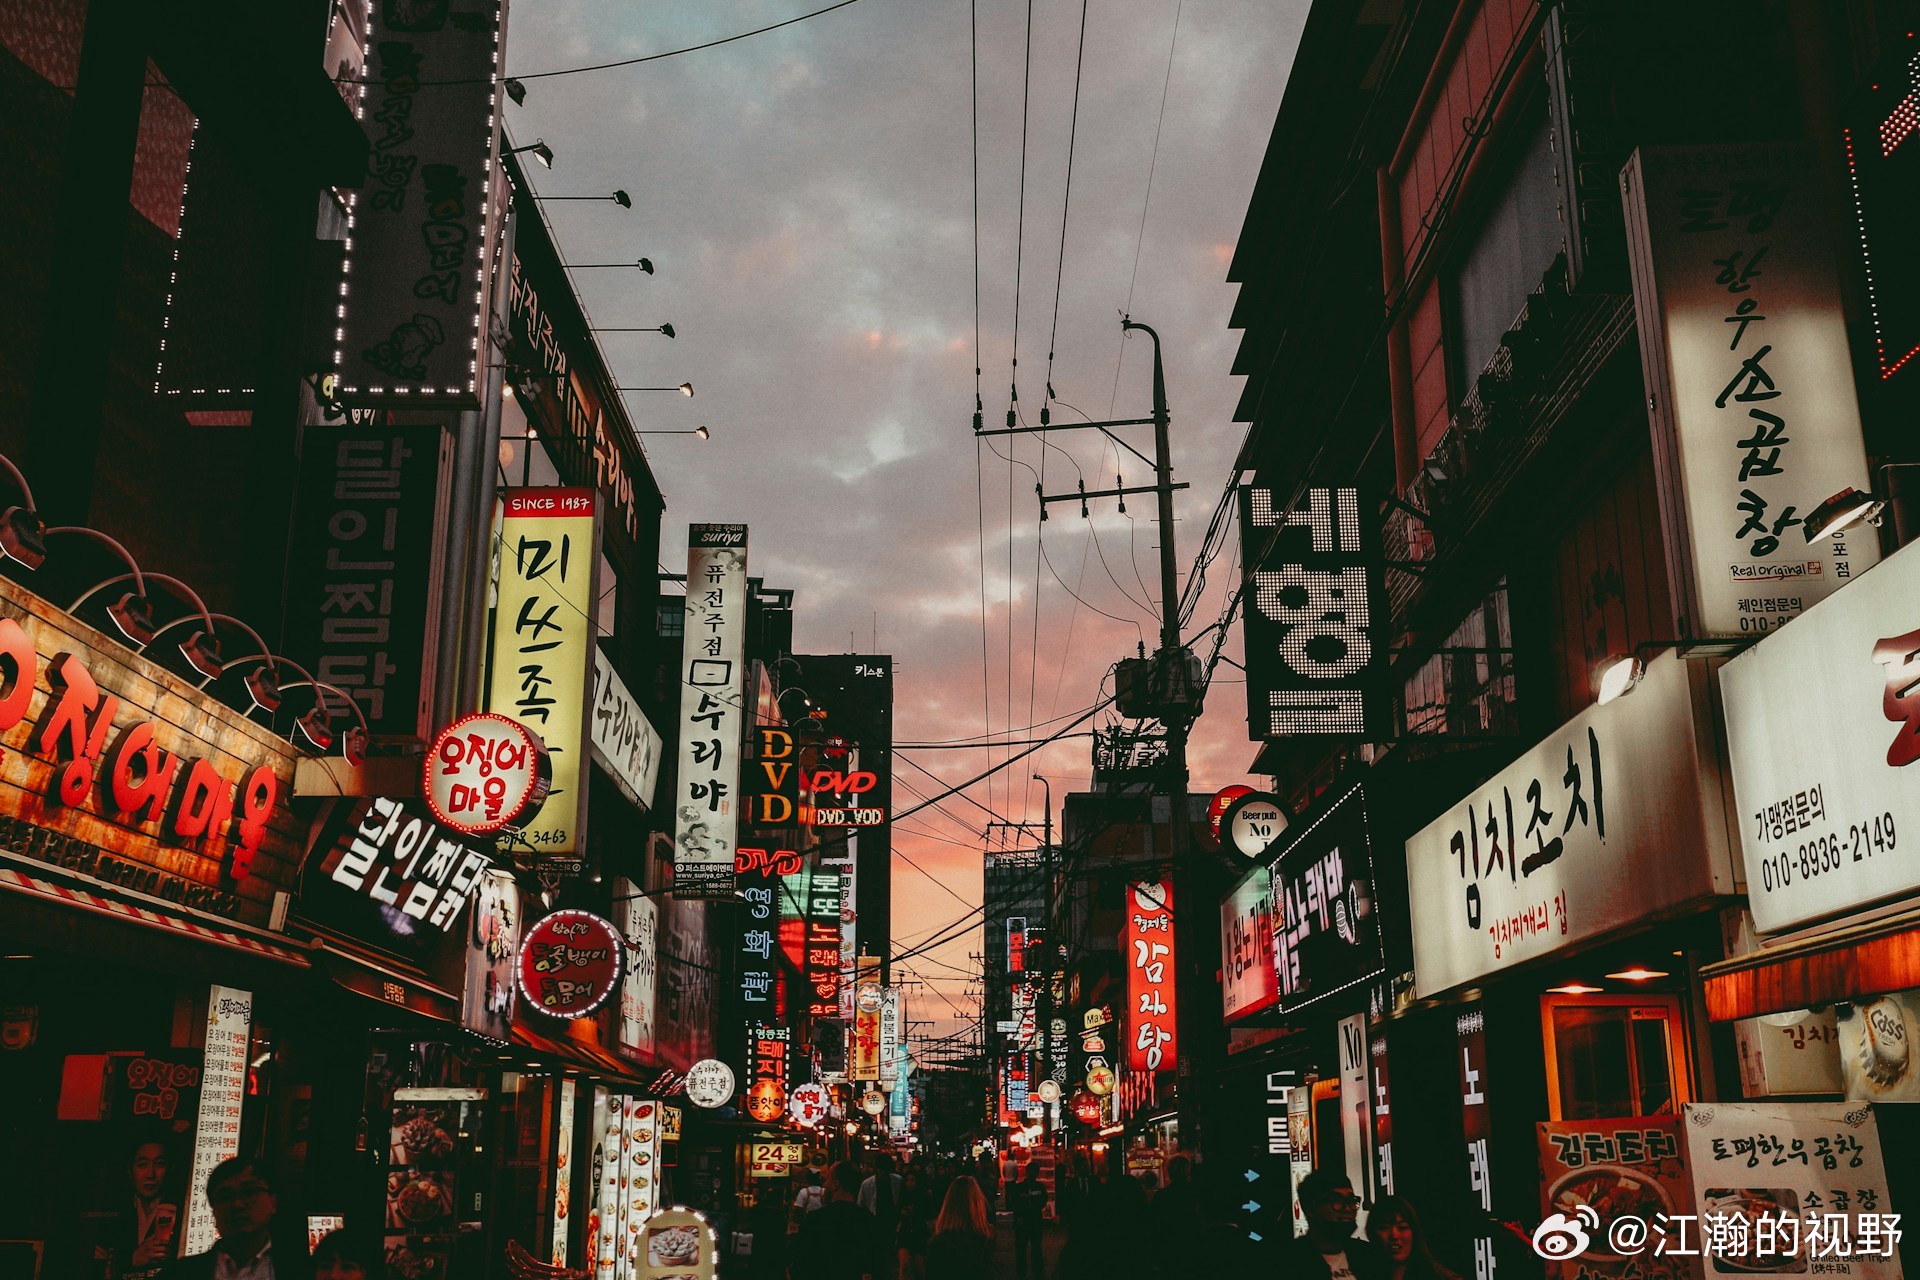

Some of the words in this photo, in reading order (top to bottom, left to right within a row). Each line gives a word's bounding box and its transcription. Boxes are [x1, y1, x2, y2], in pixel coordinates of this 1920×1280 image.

[1715, 344, 1805, 558] 소곱창
[512, 499, 555, 511] SINCE
[561, 497, 590, 510] 1987
[701, 530, 743, 545] suriya
[1731, 564, 1765, 579] Real
[702, 564, 726, 656] 퓨전주점
[1737, 597, 1802, 613] 체인점문의
[514, 534, 570, 796] 미쓰족
[440, 734, 526, 778] 오징어
[690, 693, 728, 811] 수리야
[761, 730, 793, 822] DVD
[811, 771, 877, 793] DVD
[449, 777, 506, 820] 마을
[1755, 783, 1825, 844] 가맹점문의
[1242, 811, 1261, 820] Beer
[1450, 726, 1606, 929] 김치조치
[534, 830, 566, 844] 3463
[1762, 811, 1896, 892] 010-8936-2149
[736, 849, 802, 877] DVD
[1490, 900, 1549, 959] 김치찌개의
[1555, 889, 1568, 936] 집
[1086, 1014, 1104, 1025] Max
[1135, 939, 1171, 1070] 감자탕
[755, 1028, 786, 1040] 영등포
[1870, 1009, 1904, 1041] Cass
[127, 1058, 199, 1089] 오징어
[134, 1088, 179, 1119] 마을
[758, 1146, 783, 1160] 24
[1549, 1130, 1677, 1167] 김치조치
